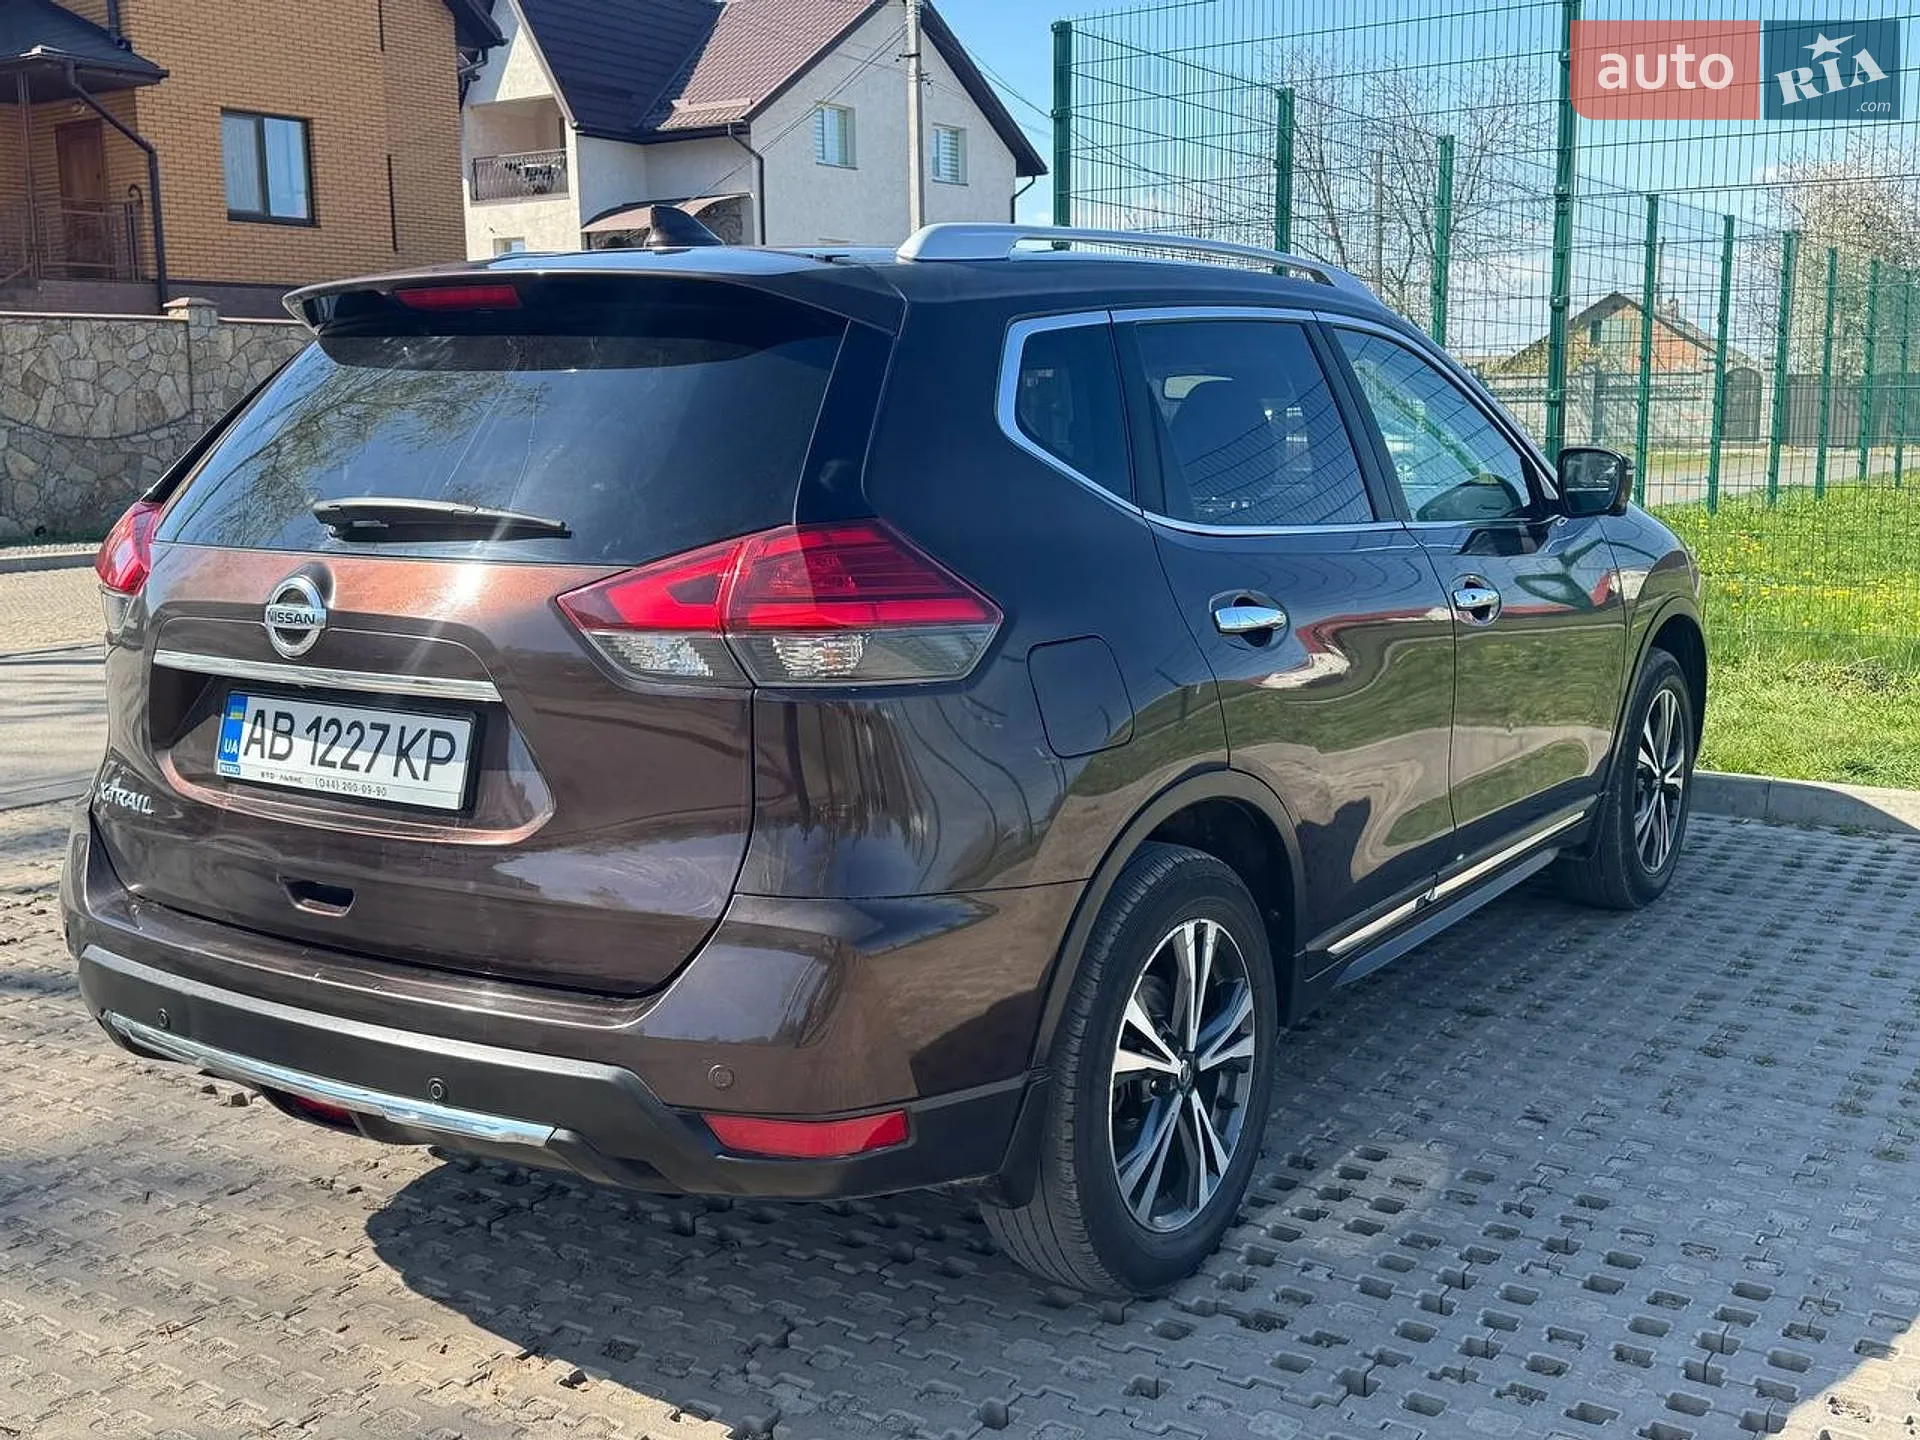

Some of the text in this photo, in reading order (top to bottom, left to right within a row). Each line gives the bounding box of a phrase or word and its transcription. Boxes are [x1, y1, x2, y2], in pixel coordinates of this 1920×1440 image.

[268, 610, 315, 624] NISSAN
[224, 738, 238, 754] UA
[304, 714, 392, 774] 1227
